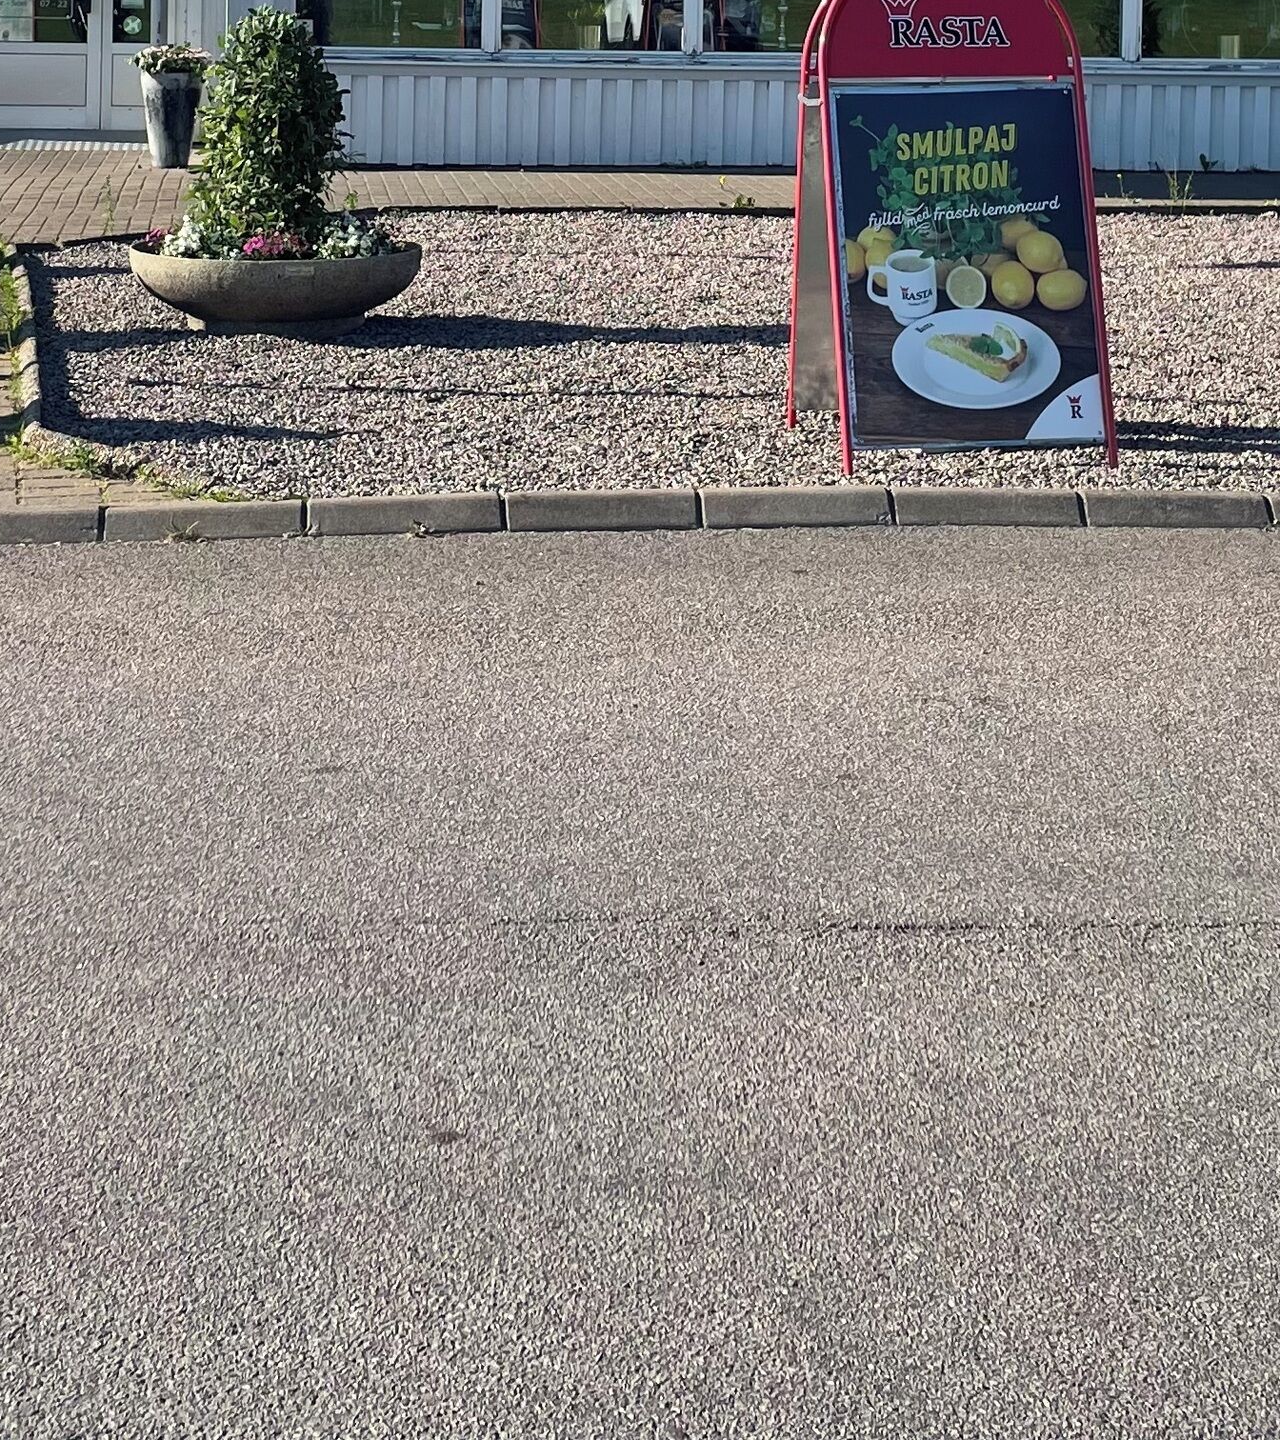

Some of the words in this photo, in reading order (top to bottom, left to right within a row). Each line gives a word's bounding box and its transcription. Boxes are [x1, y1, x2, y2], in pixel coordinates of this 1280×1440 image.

[57, 0, 68, 8] 22
[889, 17, 1011, 48] RASTA
[896, 123, 1017, 161] SMULPAJ
[914, 160, 1009, 196] CITRON
[869, 211, 903, 232] fylld
[906, 206, 932, 228] med
[933, 204, 980, 221] fräsch
[981, 195, 1061, 217] lemoncurd
[901, 286, 933, 301] RASTA
[1070, 405, 1083, 419] R
